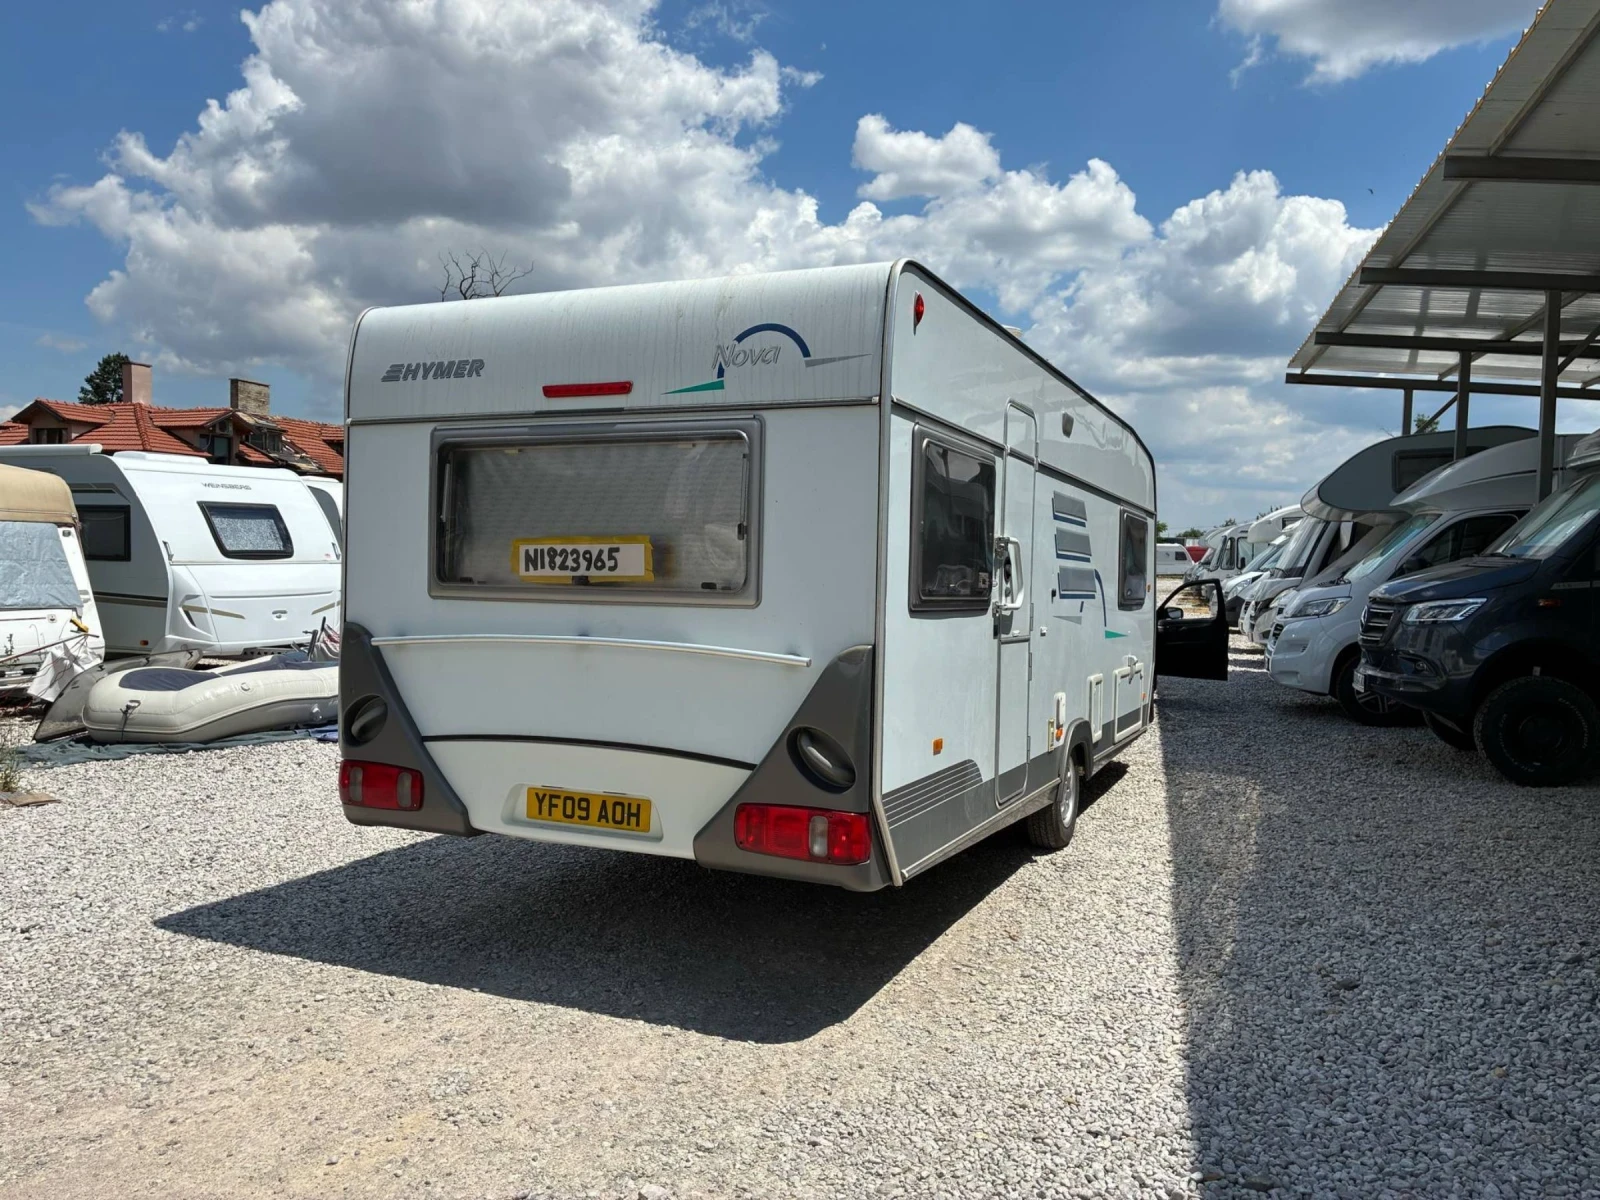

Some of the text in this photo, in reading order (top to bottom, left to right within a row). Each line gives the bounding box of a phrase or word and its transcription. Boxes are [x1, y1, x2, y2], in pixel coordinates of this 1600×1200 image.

[711, 343, 781, 370] Nova
[534, 791, 641, 828] YF09 AOH
